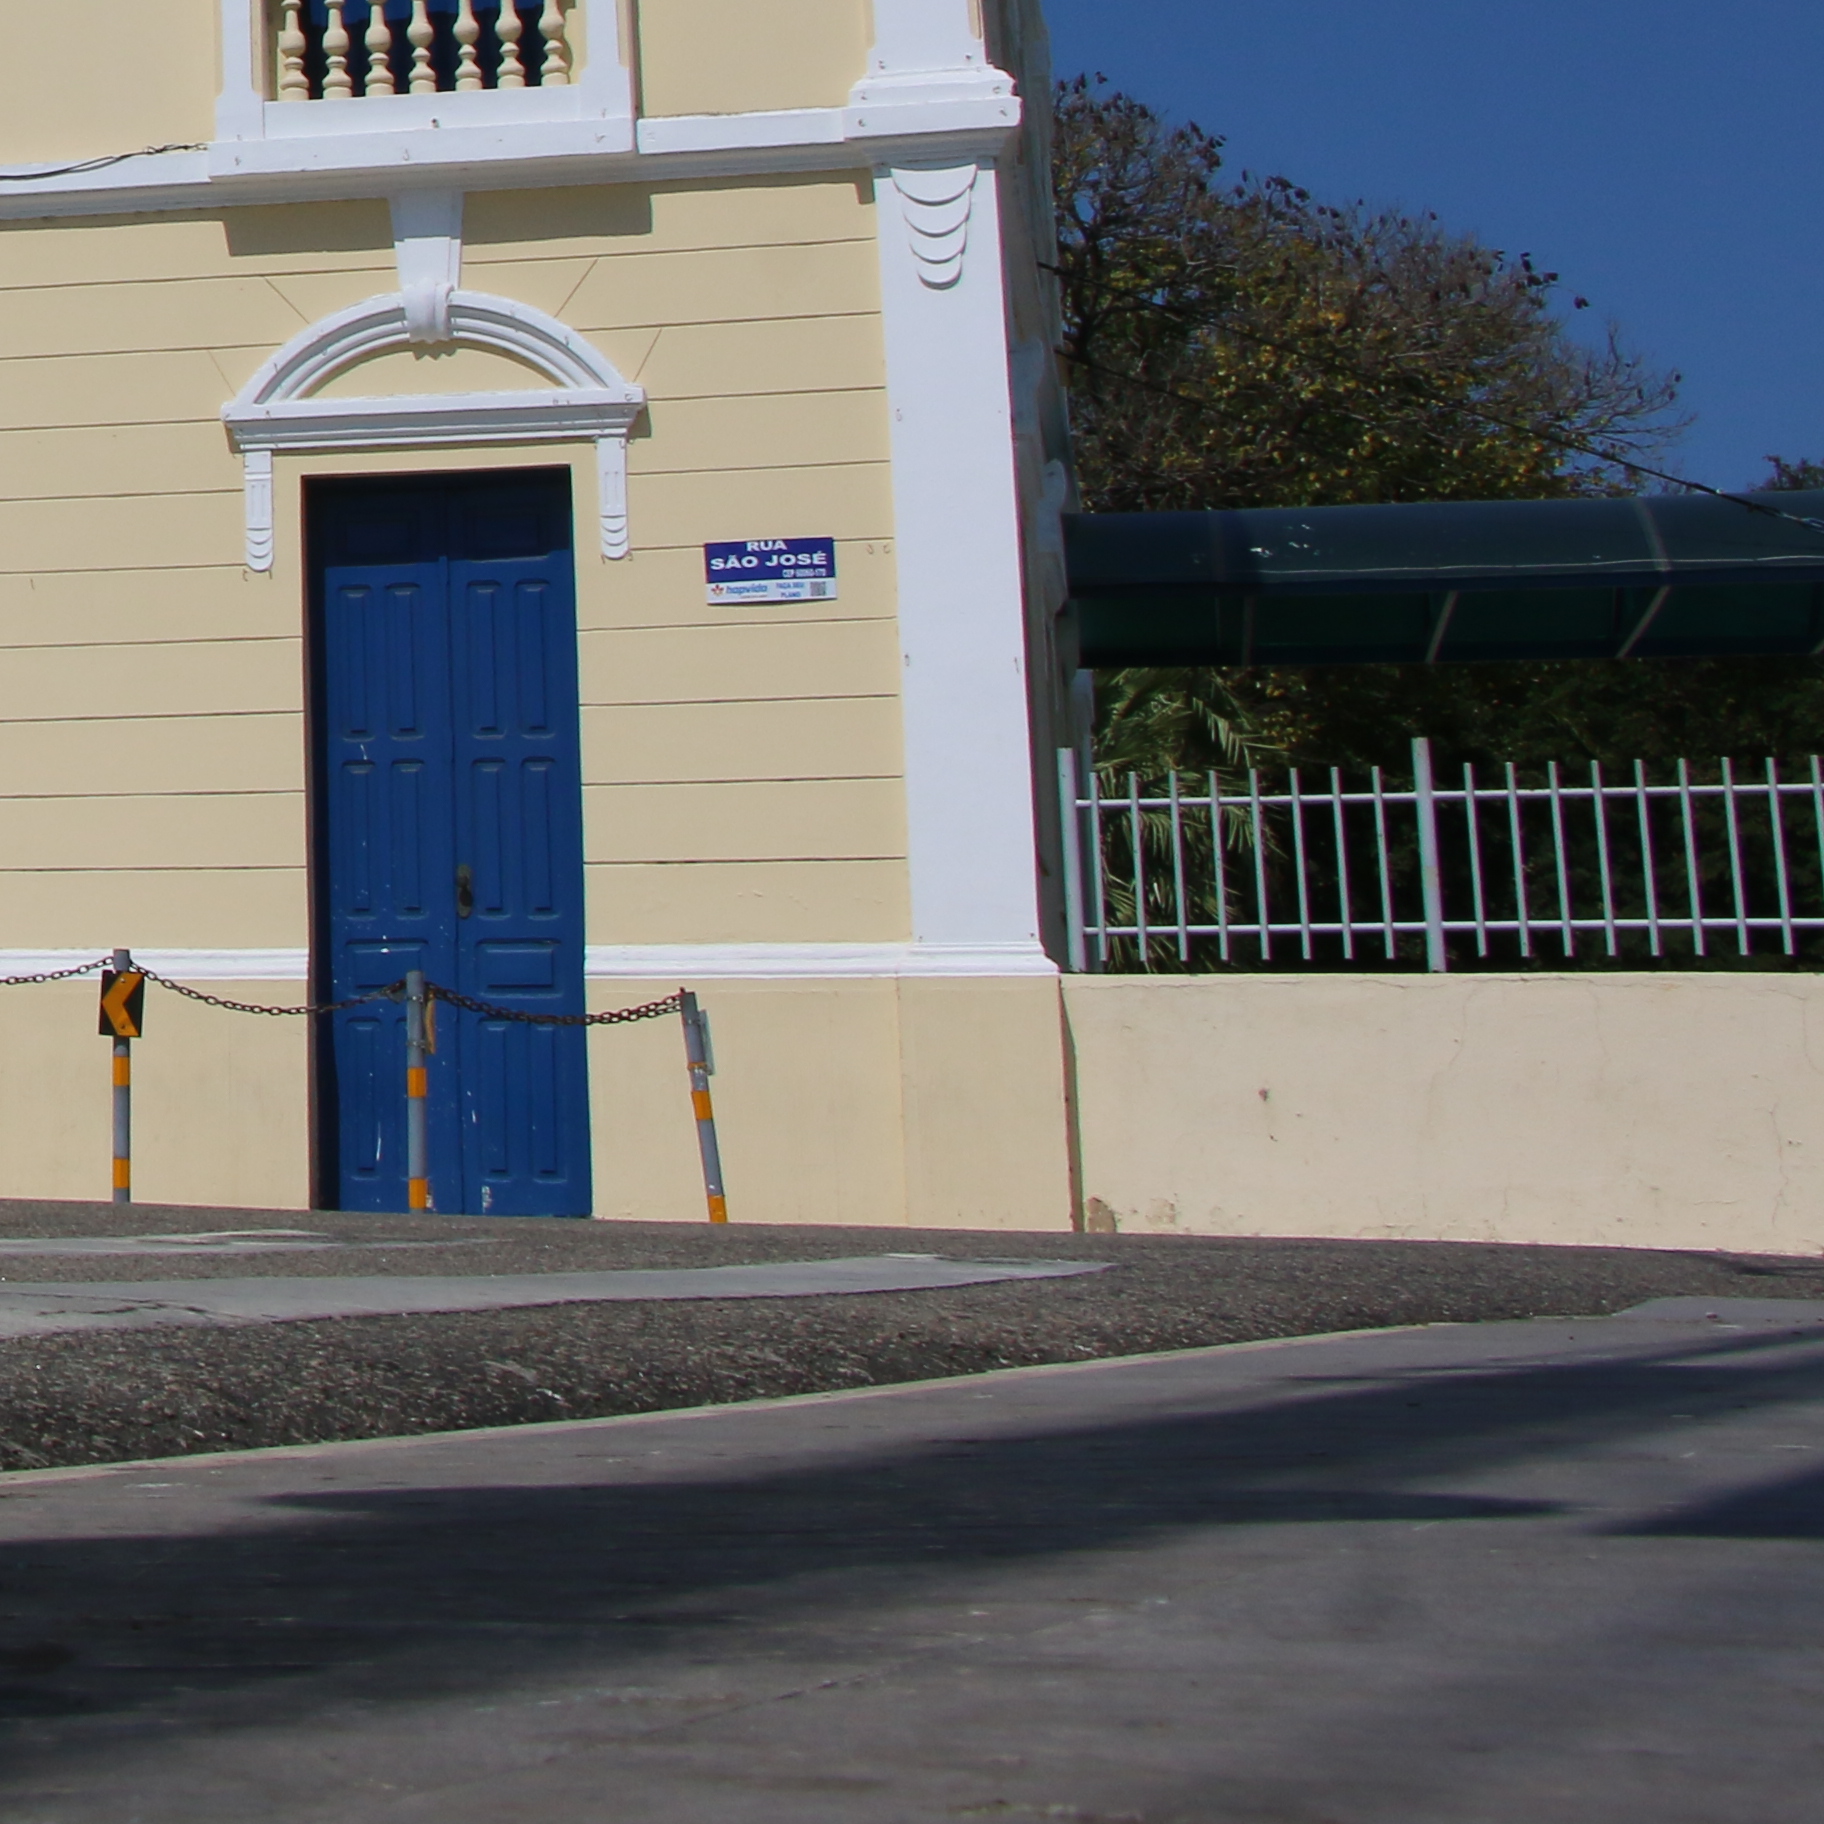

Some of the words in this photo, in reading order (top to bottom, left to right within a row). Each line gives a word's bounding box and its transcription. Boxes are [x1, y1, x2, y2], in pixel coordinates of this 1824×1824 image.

[747, 539, 787, 551] RUA
[710, 555, 758, 570] SÃO
[765, 551, 827, 566] JOSÉ
[726, 584, 767, 595] hapvida
